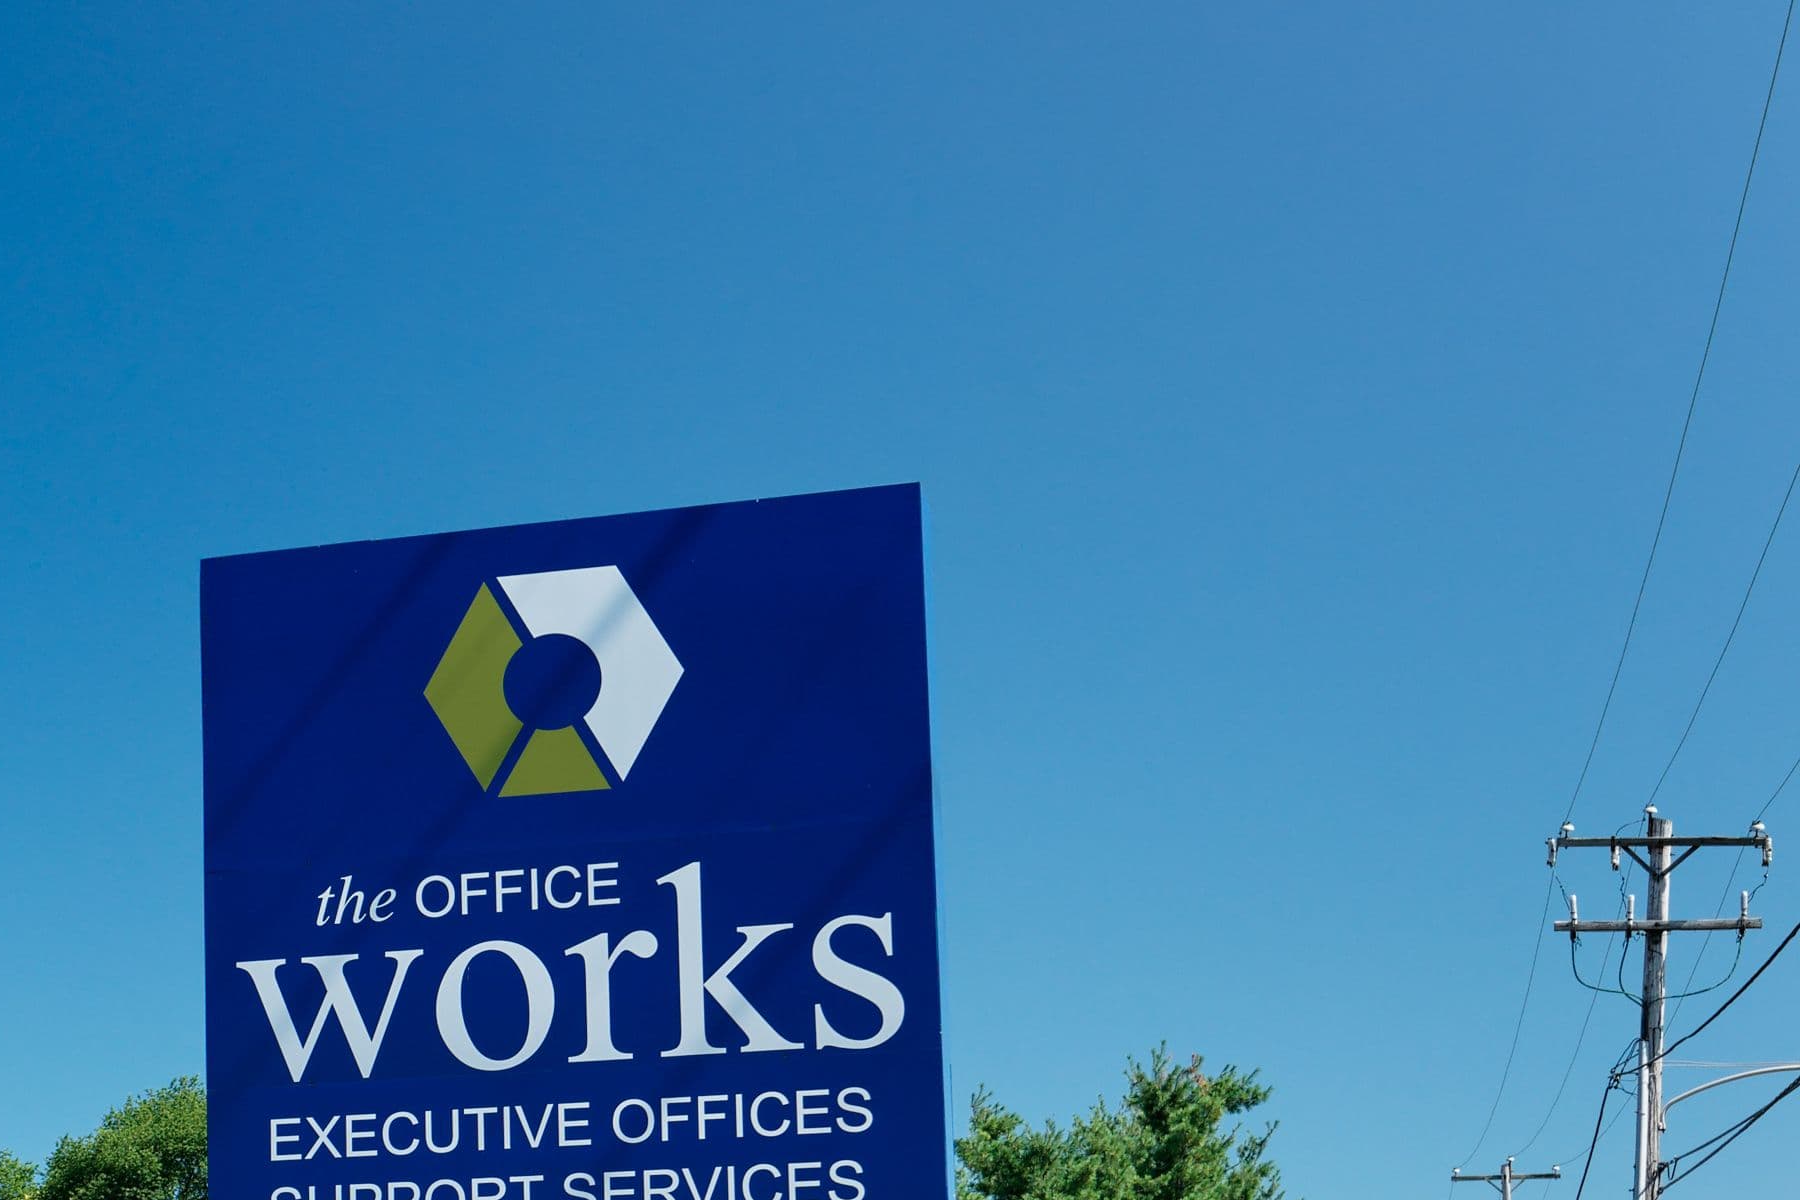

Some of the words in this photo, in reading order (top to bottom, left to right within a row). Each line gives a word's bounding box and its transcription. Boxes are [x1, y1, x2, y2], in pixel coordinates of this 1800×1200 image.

[316, 874, 397, 927] the
[415, 861, 621, 918] OFFICE
[235, 861, 905, 1083] works
[270, 1101, 592, 1162] EXECUTIVE
[612, 1086, 874, 1144] OFFICES
